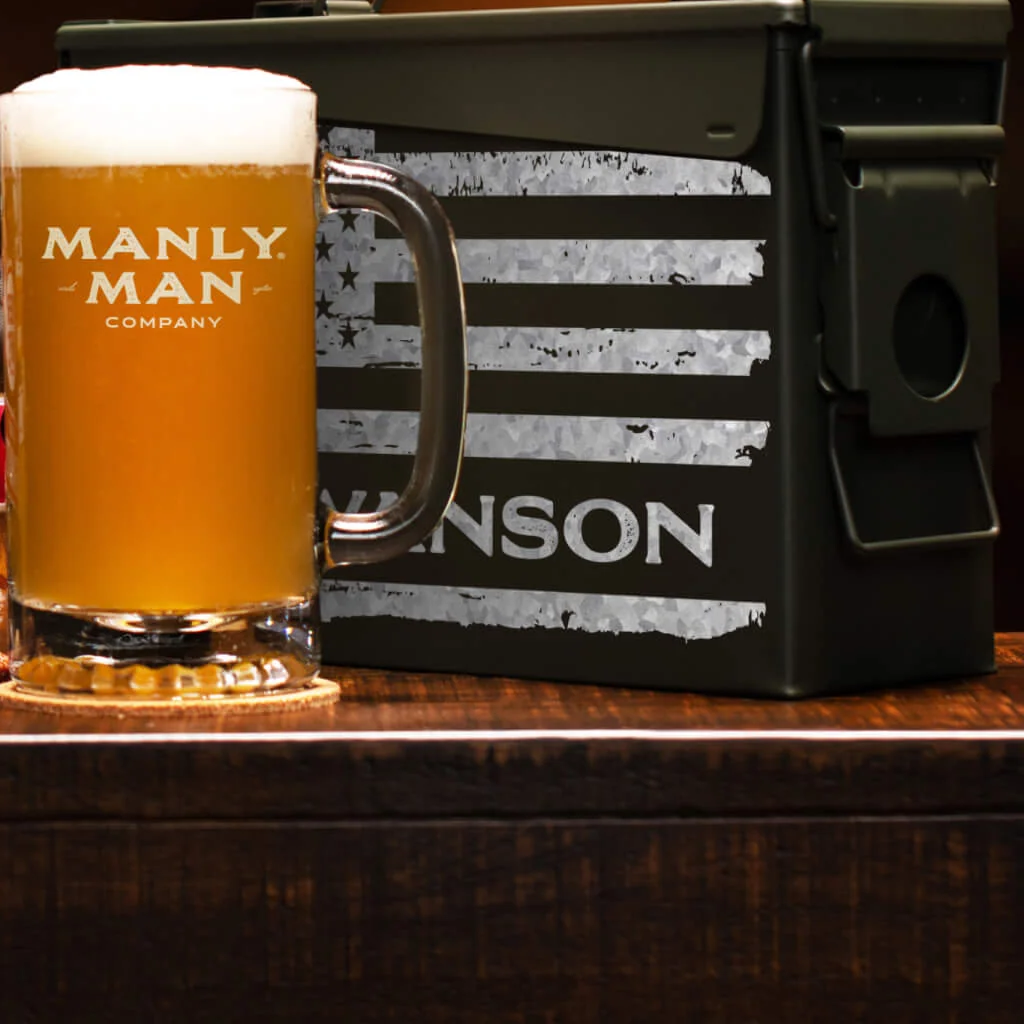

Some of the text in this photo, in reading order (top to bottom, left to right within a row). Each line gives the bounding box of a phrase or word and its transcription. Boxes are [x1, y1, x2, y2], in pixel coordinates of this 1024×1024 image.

[41, 226, 287, 260] MANLY
[85, 271, 244, 305] MAN
[105, 316, 223, 329] COMPANY
